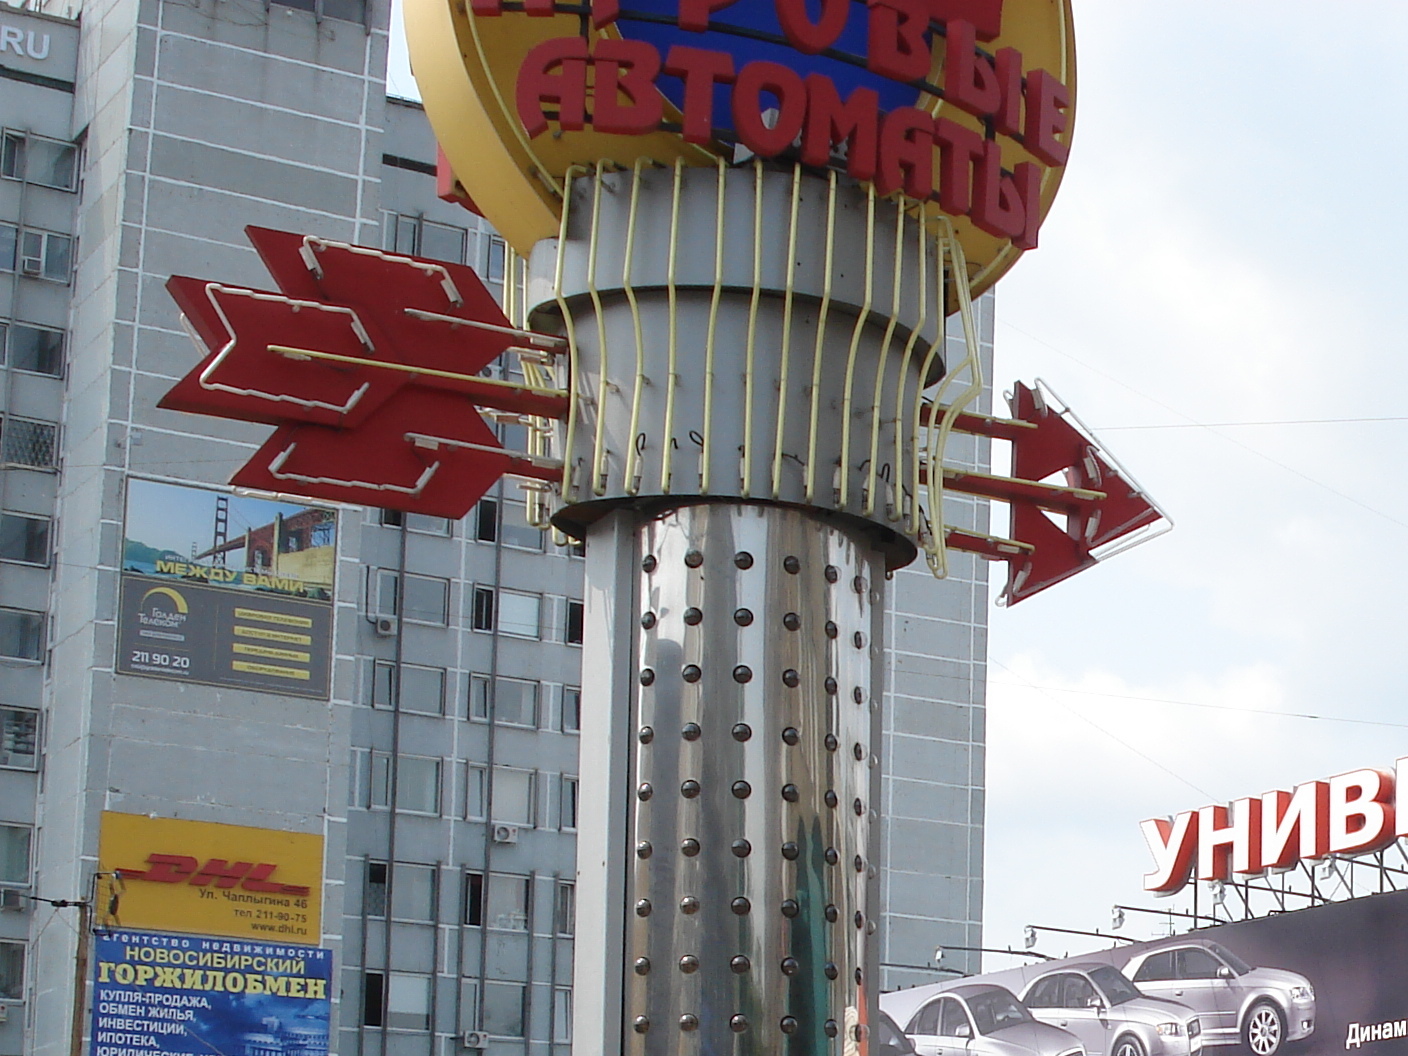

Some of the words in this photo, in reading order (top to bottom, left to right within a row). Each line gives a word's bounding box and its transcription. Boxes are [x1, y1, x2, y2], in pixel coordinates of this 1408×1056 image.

[470, 0, 1071, 168] ОВЫЕ
[515, 36, 1042, 251] АВТОМАТЫ
[156, 559, 237, 583] МЕЖДУ
[243, 573, 305, 594] ВАМИ
[131, 651, 149, 663] 211
[152, 653, 170, 666] 90
[172, 656, 190, 668] 20
[138, 853, 302, 896] DHL
[199, 888, 218, 900] Ул.
[222, 889, 290, 908] Чаплыгина
[256, 909, 307, 923] 211-90-75
[251, 922, 307, 936] www.dhl.ru
[103, 933, 190, 949] агентство
[202, 941, 325, 960] недвижимости
[125, 946, 305, 975] НОВОСИБИРСКИЙ
[98, 961, 327, 999] ГОРЖИЛОБМЕН
[100, 989, 212, 1010] КУПЛЯ-ПРОДАЖА,
[99, 1001, 145, 1017] ОБМЕН
[147, 1006, 197, 1023] ЖИЛЬЯ,
[98, 1017, 188, 1037] ИНВЕСТИЦИИ,
[97, 1031, 160, 1049] ИПОТЕКА,
